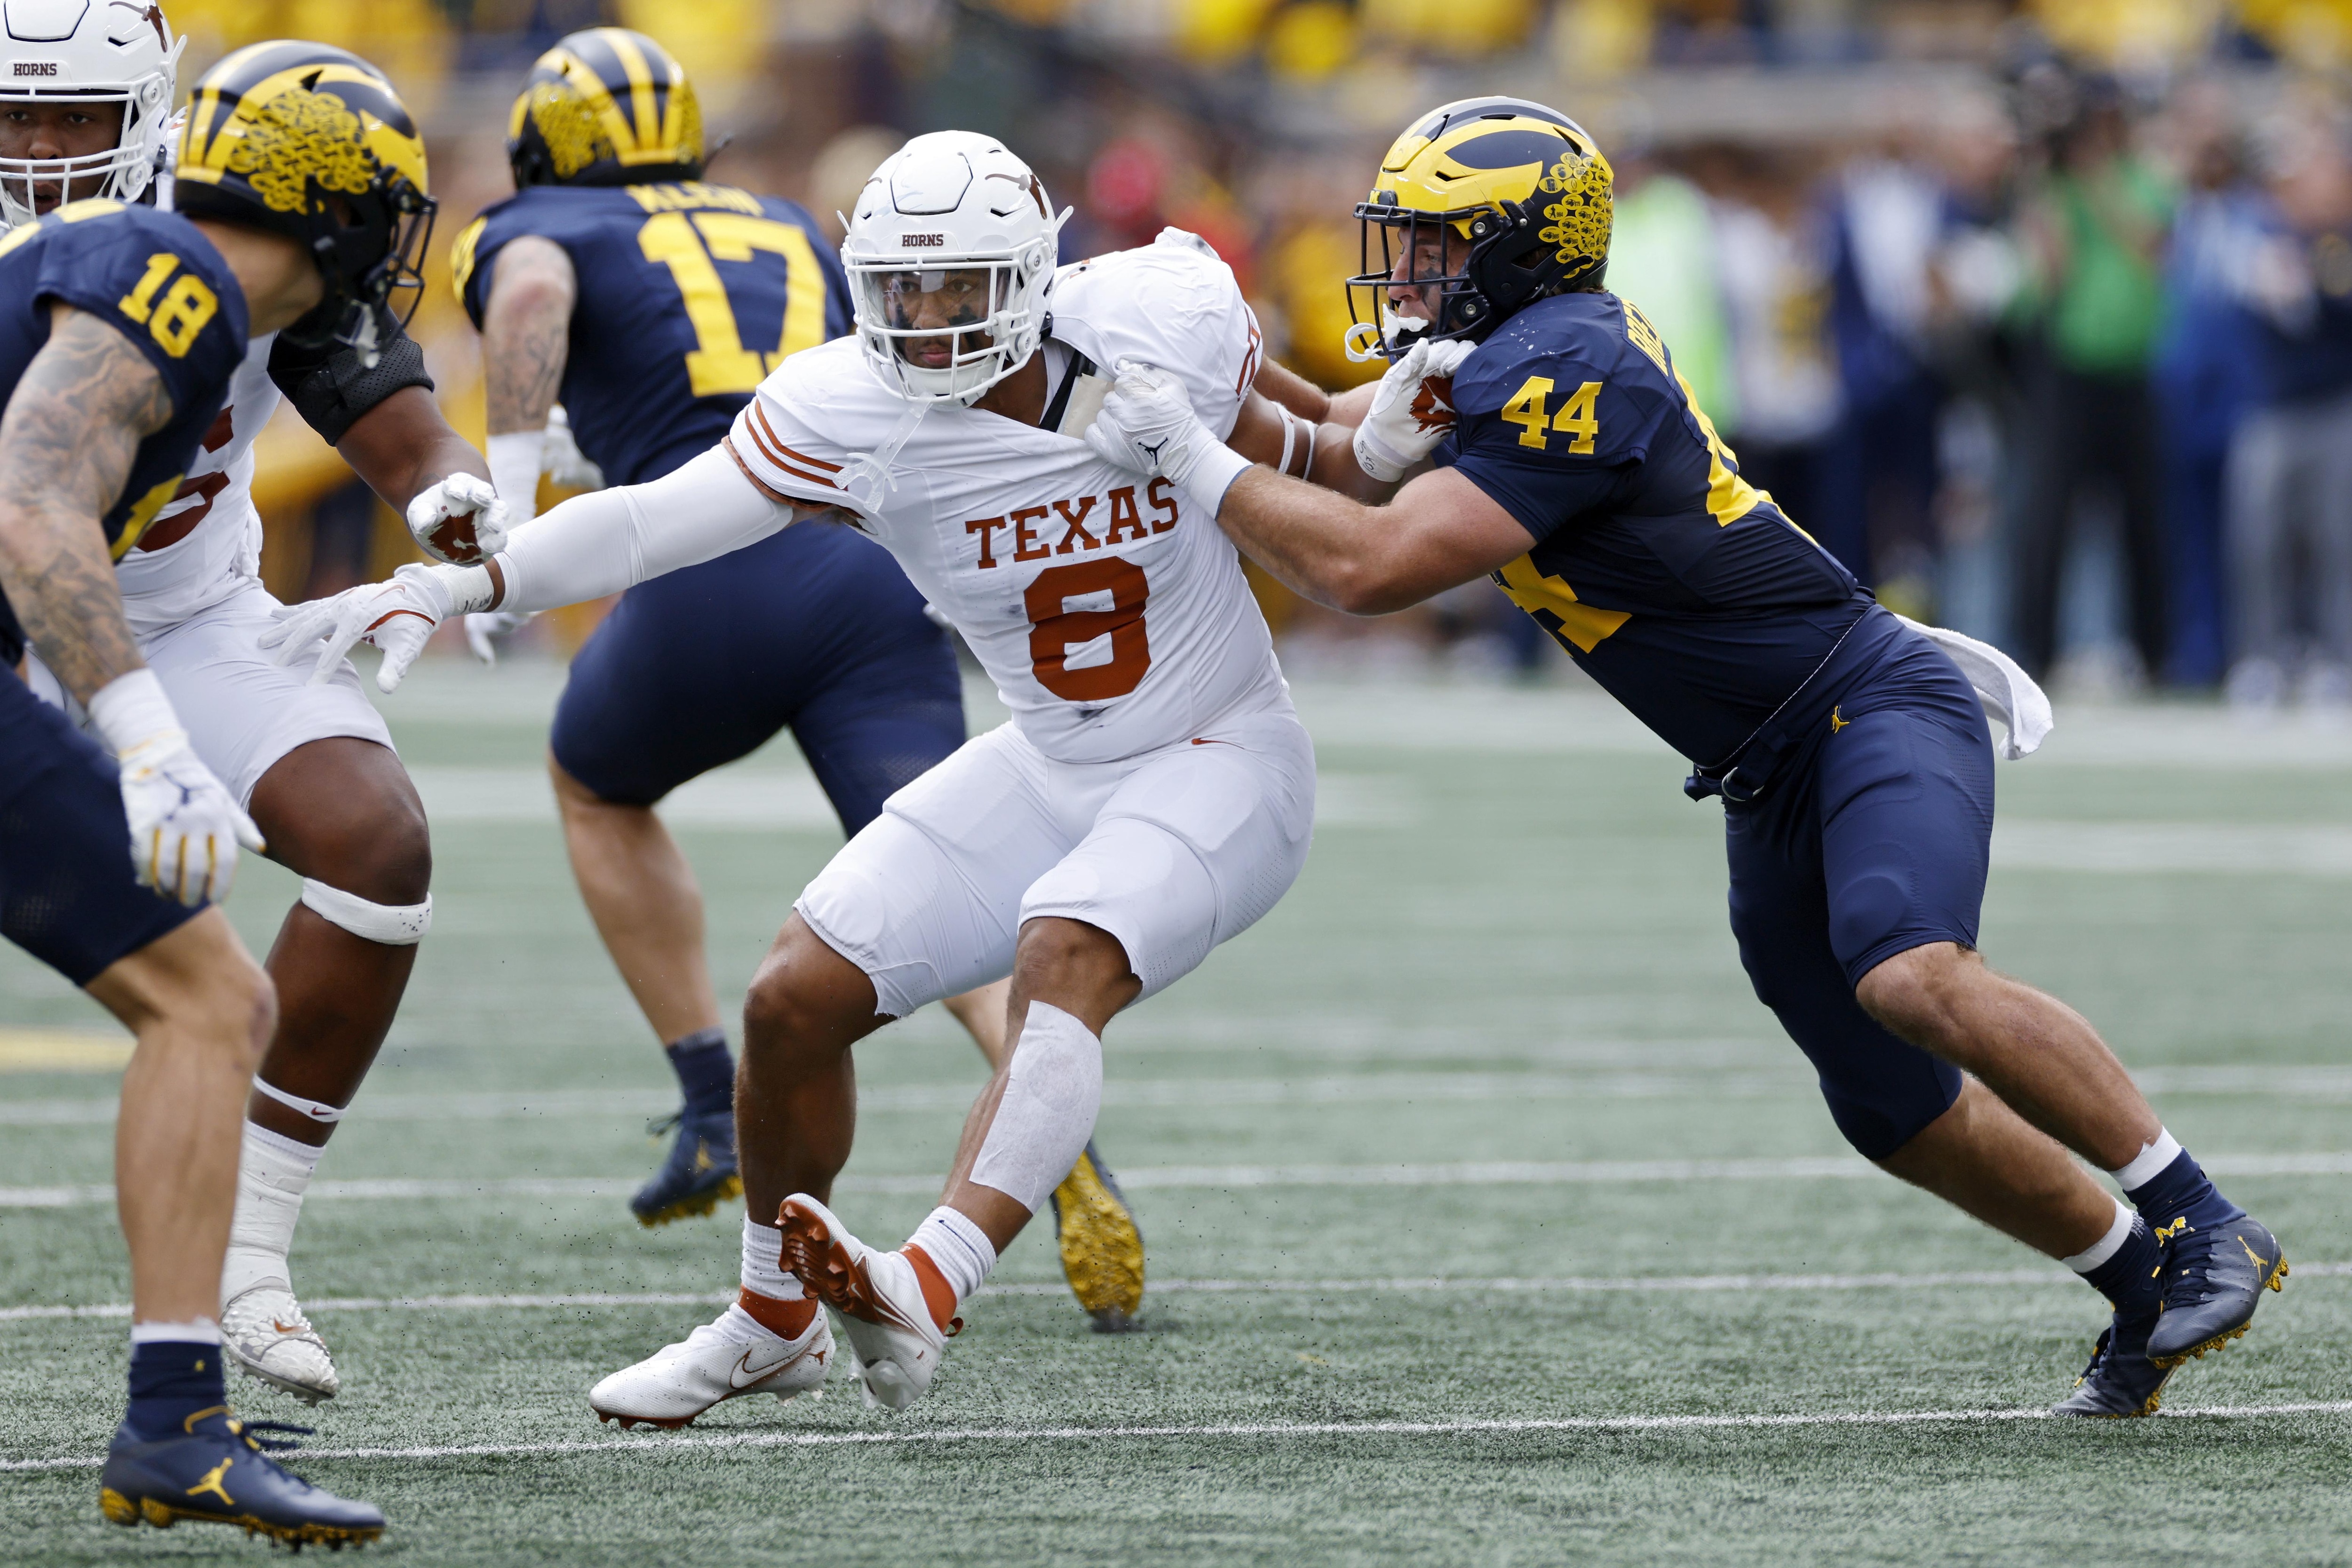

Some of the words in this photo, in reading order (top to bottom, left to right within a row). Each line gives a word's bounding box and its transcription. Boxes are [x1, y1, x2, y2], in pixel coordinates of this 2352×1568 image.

[13, 63, 57, 76] HORNS
[902, 234, 944, 247] HORNS
[118, 253, 218, 358] 18
[637, 210, 826, 398] 17
[1501, 375, 1603, 455] 44
[965, 476, 1179, 569] TEXAS
[1023, 555, 1152, 701] 8
